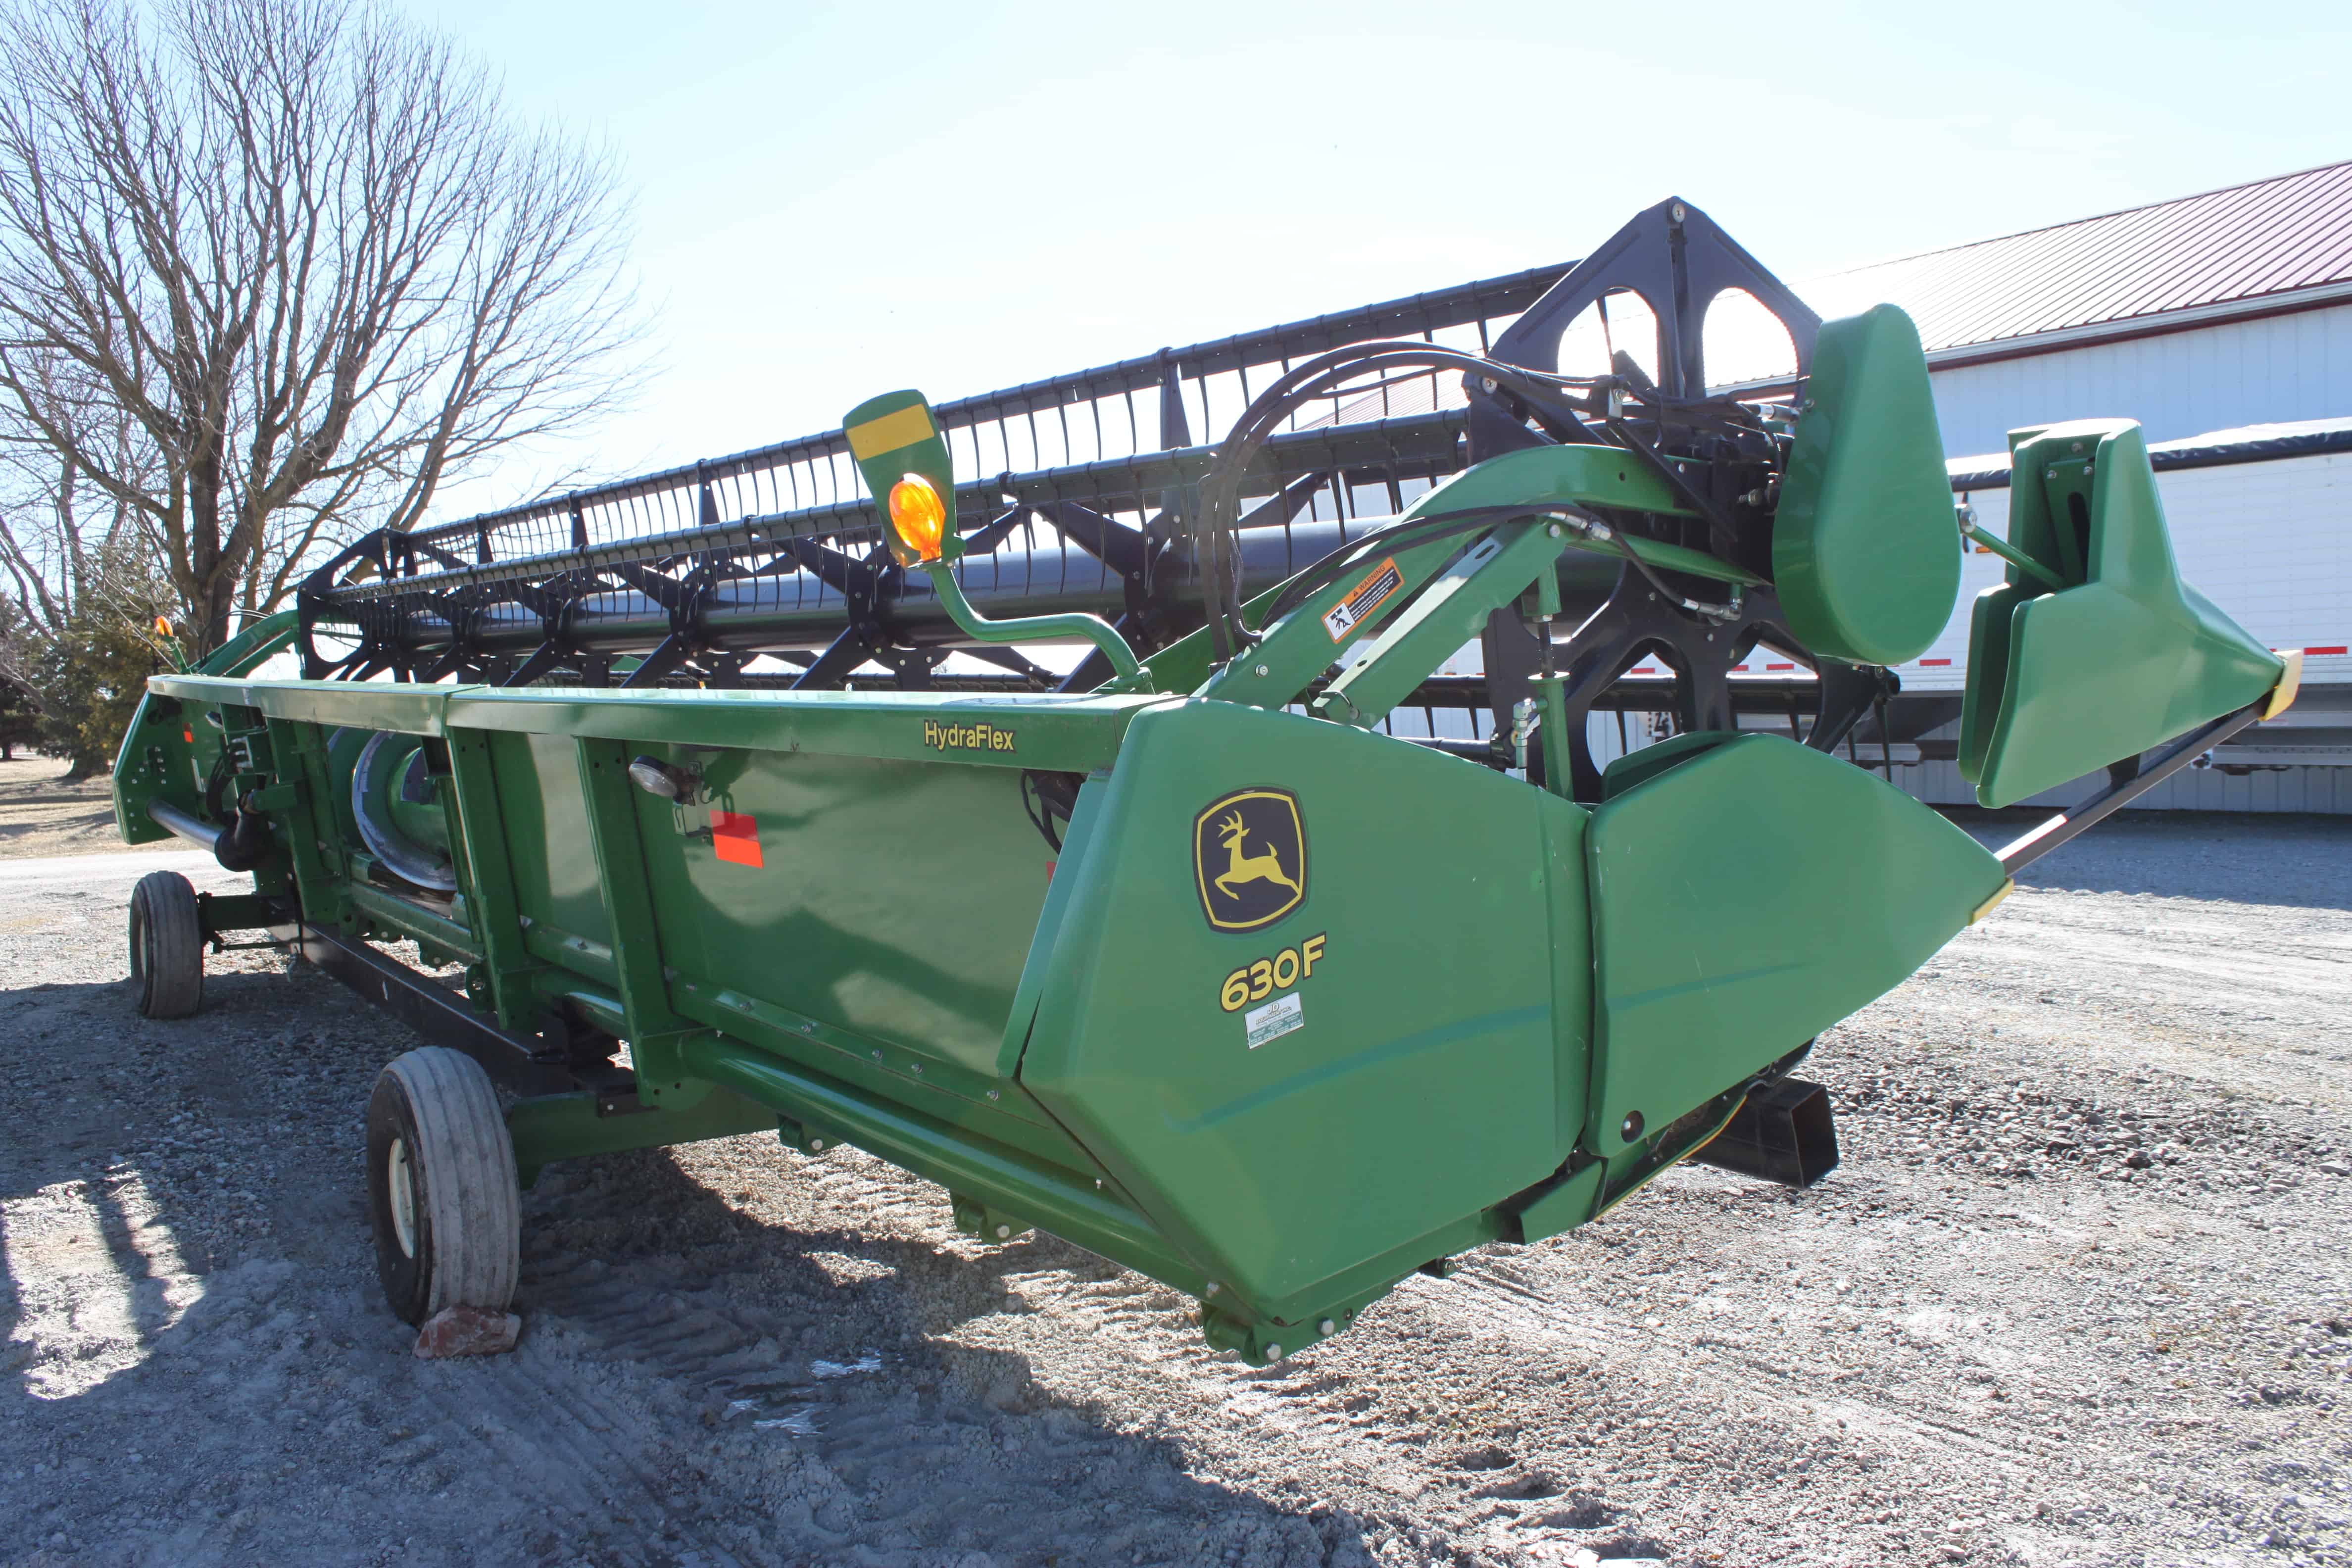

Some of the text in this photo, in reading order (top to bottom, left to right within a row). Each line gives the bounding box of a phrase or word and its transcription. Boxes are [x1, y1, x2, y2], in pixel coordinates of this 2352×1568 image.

[1358, 565, 1385, 590] WARNING
[924, 721, 1015, 751] HydraFlex
[1220, 932, 1326, 1012] 630F
[1267, 1003, 1280, 1014] JD
